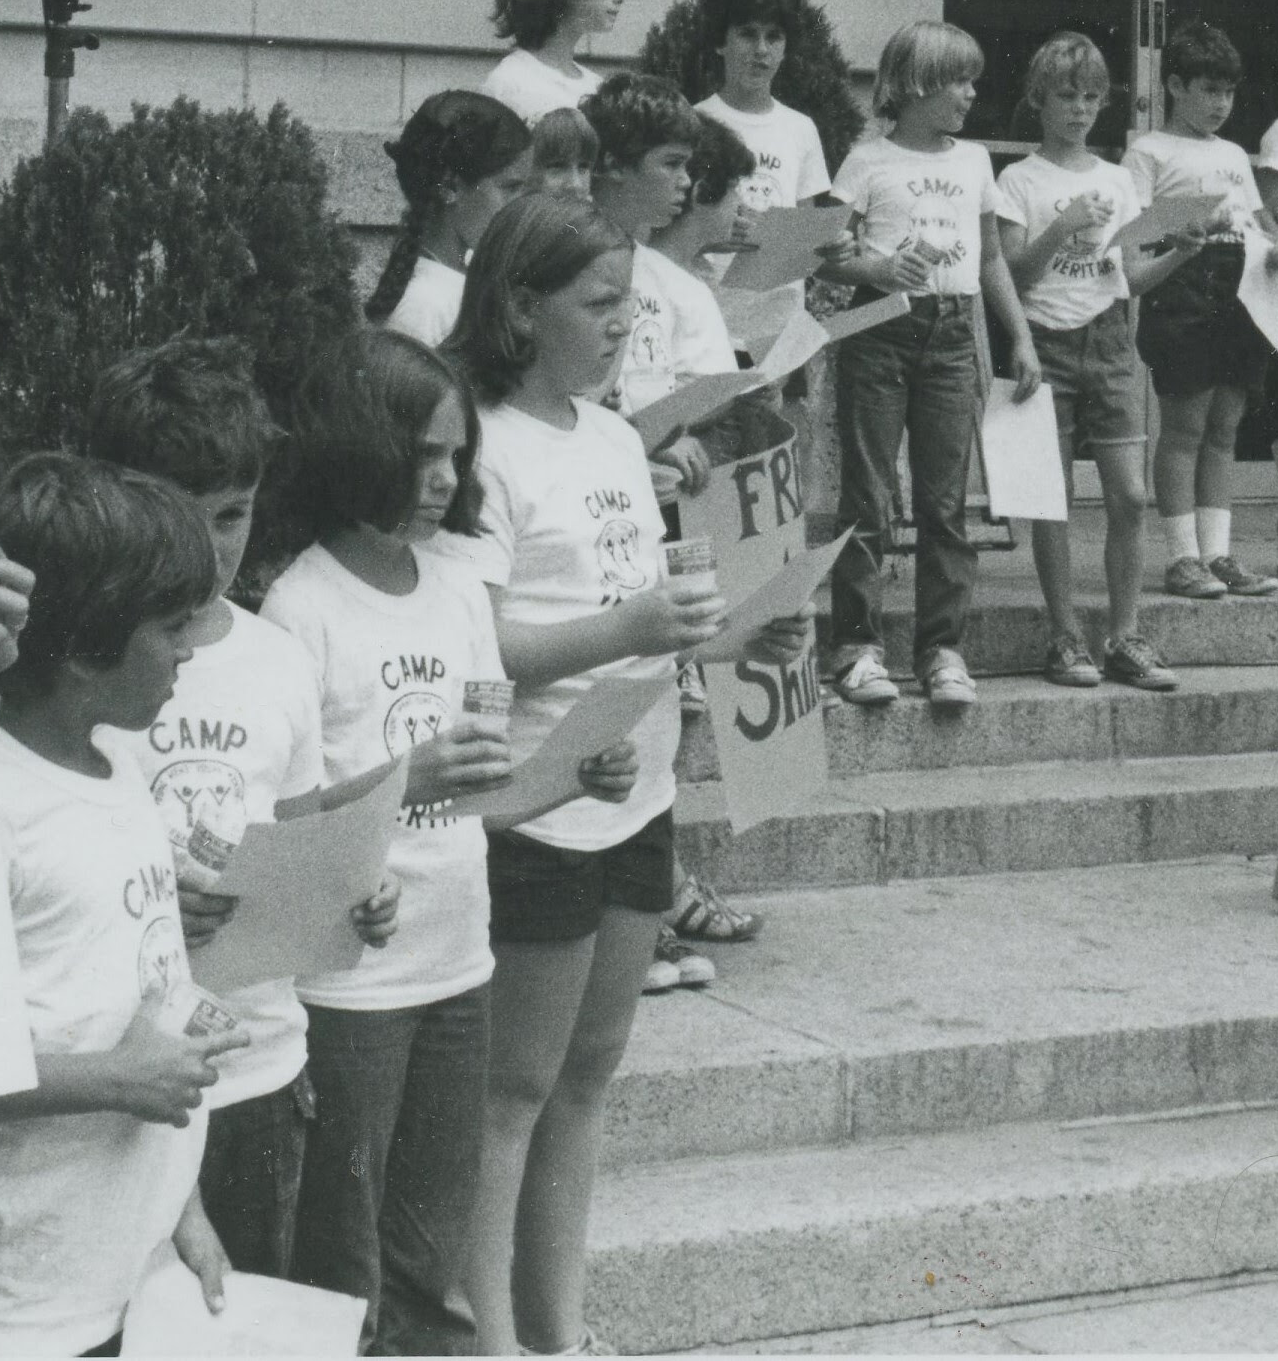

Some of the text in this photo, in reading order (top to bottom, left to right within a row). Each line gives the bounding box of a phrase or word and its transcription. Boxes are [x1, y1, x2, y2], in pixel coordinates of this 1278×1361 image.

[907, 178, 964, 198] CAMP
[585, 489, 631, 519] CAMP
[381, 654, 445, 690] CAMP
[149, 718, 247, 754] CAMP
